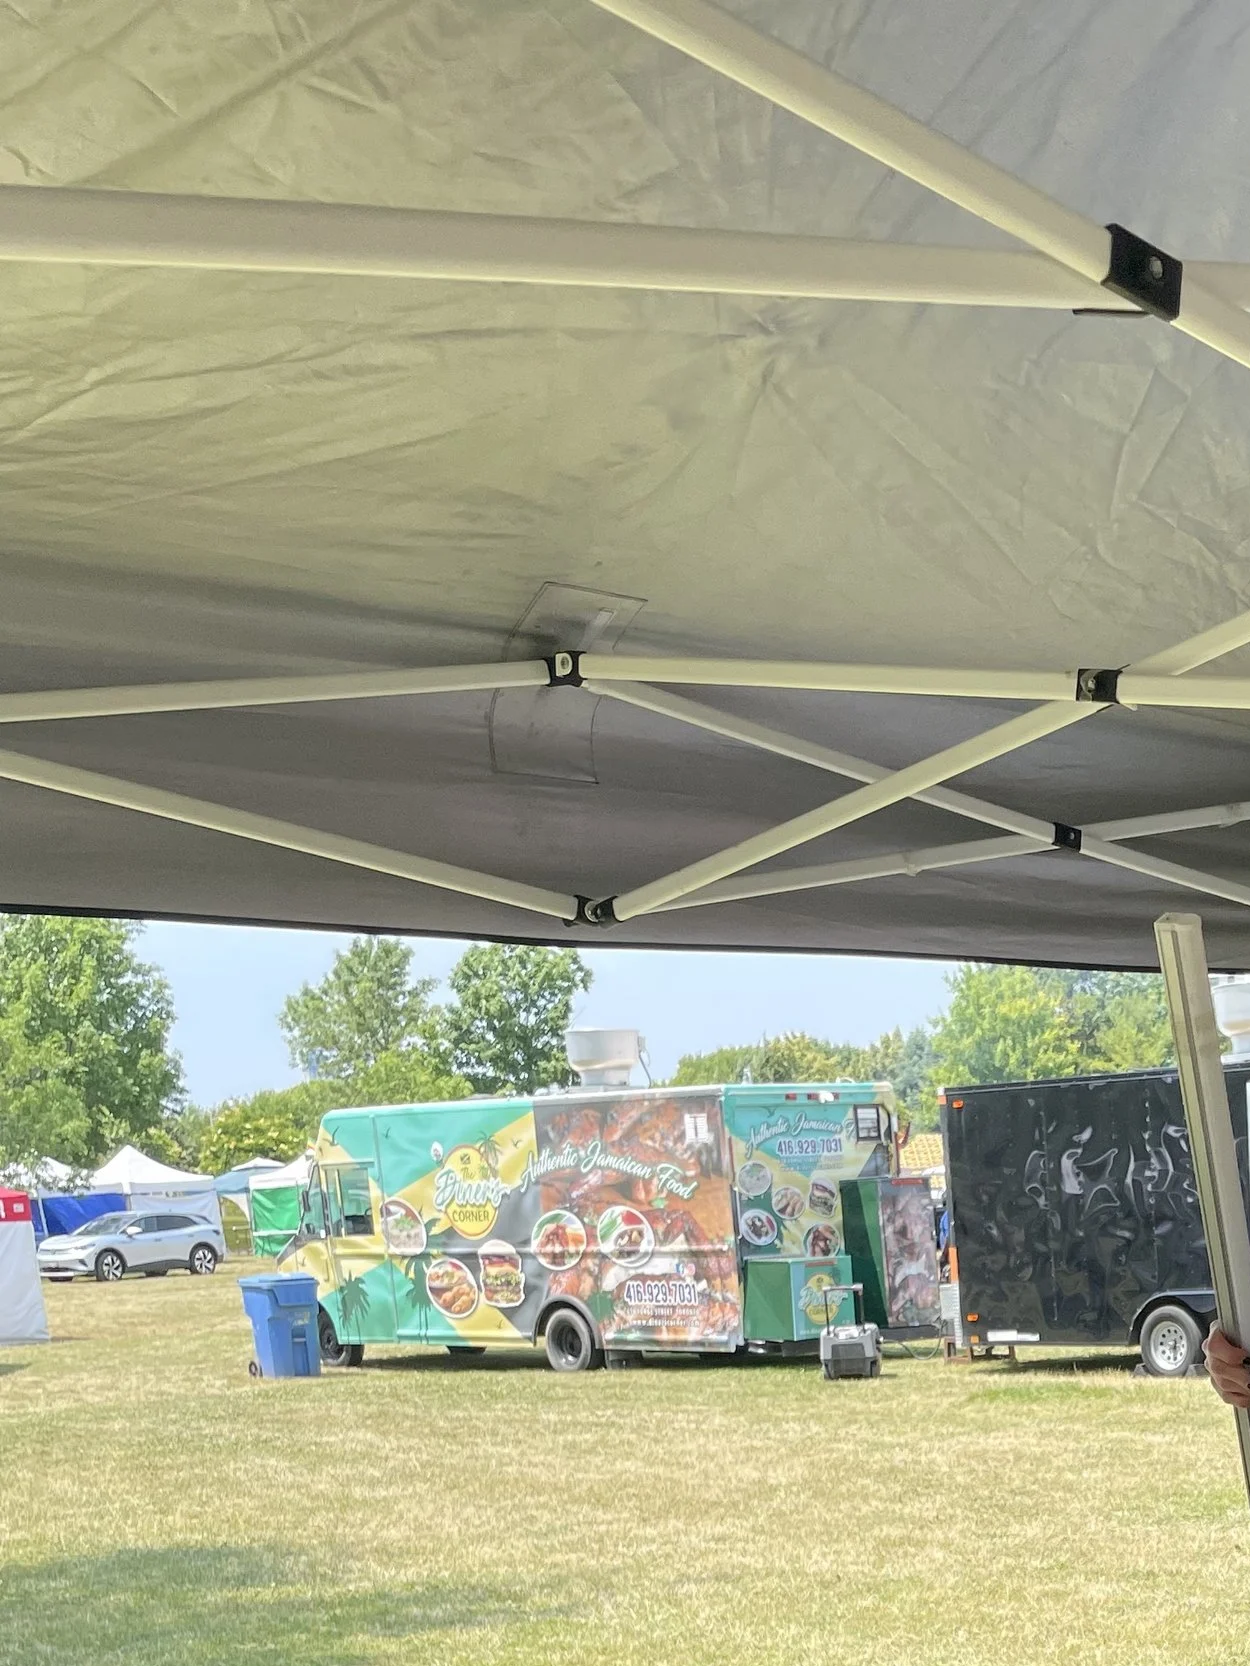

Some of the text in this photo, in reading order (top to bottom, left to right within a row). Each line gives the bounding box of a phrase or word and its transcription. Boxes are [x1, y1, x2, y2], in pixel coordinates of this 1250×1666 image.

[746, 1117, 788, 1158] Authentic
[791, 1112, 842, 1136] Jamaican
[777, 1139, 842, 1155] 416.929.7031
[520, 1141, 698, 1200] Authentic Jamaican Food
[452, 1210, 490, 1223] CORNER
[625, 1282, 698, 1303] 416.929.7031
